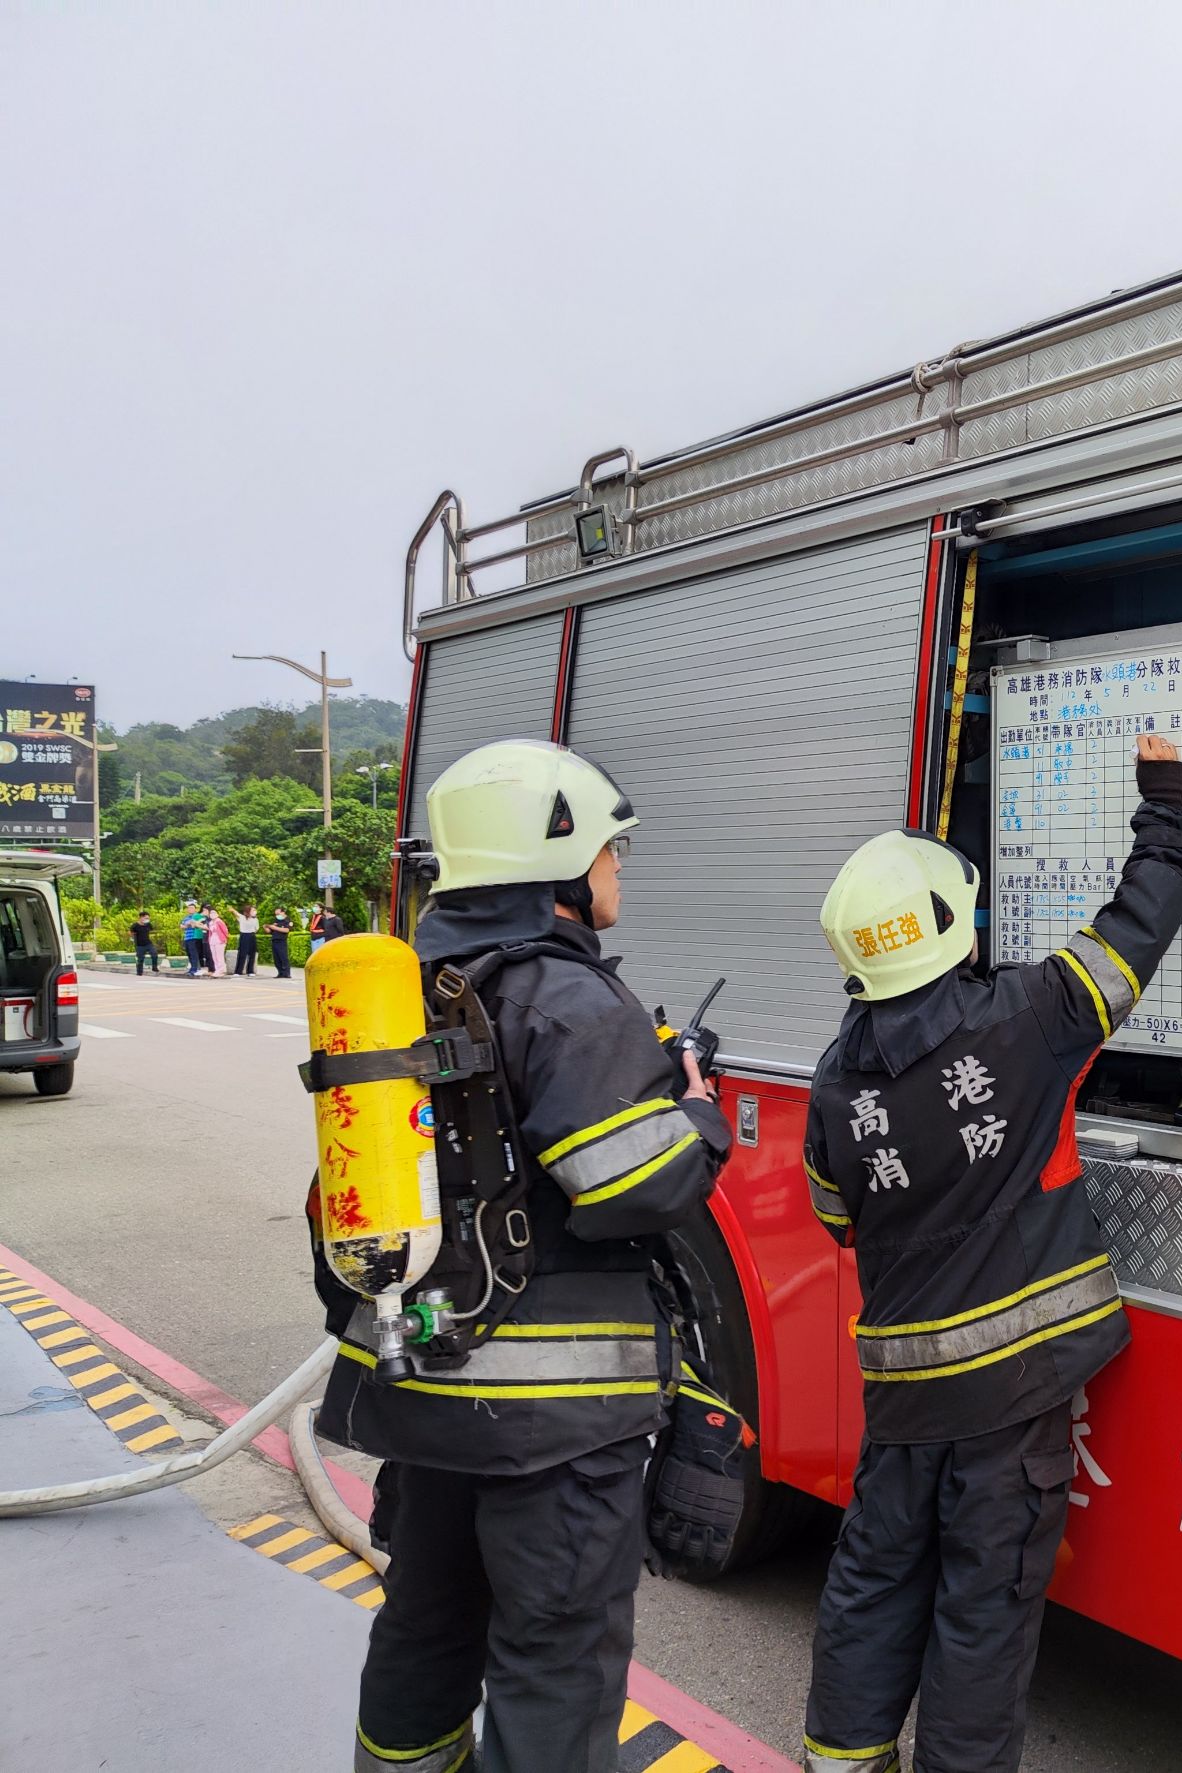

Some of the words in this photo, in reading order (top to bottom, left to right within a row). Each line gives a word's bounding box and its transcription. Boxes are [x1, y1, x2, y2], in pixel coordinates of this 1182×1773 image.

[1007, 667, 1102, 694] 高雄港務消防隊
[1084, 690, 1093, 702] 年
[1104, 688, 1110, 698] 5
[1122, 685, 1129, 697] 月
[1143, 681, 1157, 691] 22
[1168, 679, 1175, 692] 日
[0, 709, 86, 735] 灣之光
[1144, 714, 1181, 731] 備註
[1001, 728, 1032, 743] 出勤單位
[1000, 875, 1032, 890] 人員代號
[1001, 893, 1020, 904] 救助
[1024, 894, 1031, 904] 主
[1003, 906, 1020, 917] 1號
[1023, 906, 1031, 918] 副
[1001, 922, 1020, 932] 救助
[1024, 922, 1031, 932] 主
[853, 911, 925, 958] 張任強
[1002, 935, 1020, 946] 2號
[1023, 935, 1031, 946] 副
[1001, 950, 1020, 960] 救助
[1024, 950, 1031, 960] 主
[1151, 1032, 1166, 1044] 42
